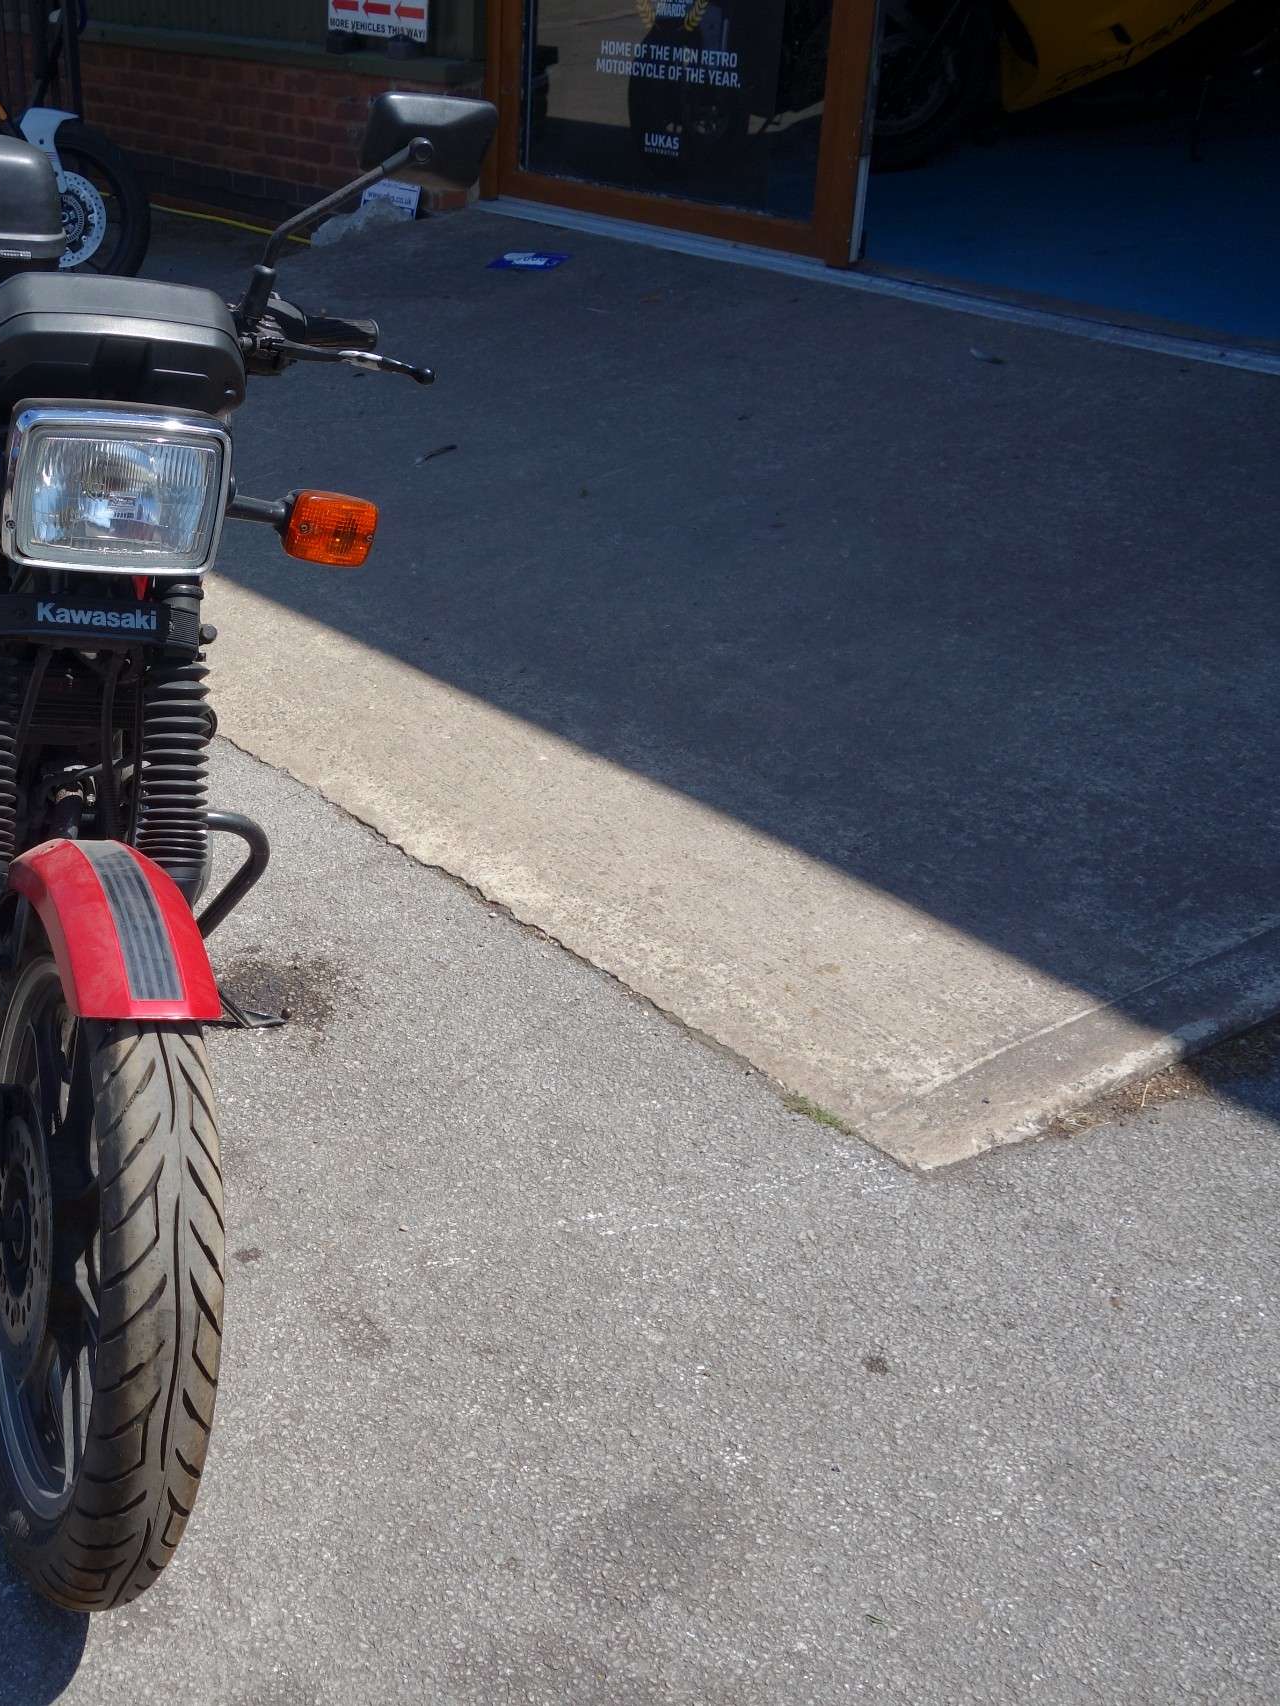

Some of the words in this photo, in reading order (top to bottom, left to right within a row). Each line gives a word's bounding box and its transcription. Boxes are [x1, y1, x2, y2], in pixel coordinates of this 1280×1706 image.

[655, 4, 686, 17] AWARDS
[329, 18, 349, 29] MORE
[351, 20, 386, 33] VEHICLES
[600, 40, 632, 57] HOME
[634, 43, 648, 58] OF
[650, 45, 670, 60] THE
[673, 47, 699, 63] MCN
[701, 51, 738, 67] RETRO
[596, 58, 665, 79] MOTORCYCLE
[668, 65, 682, 81] OF
[685, 67, 705, 83] THE
[708, 70, 741, 88] YEAR.
[644, 132, 680, 149] LUKAS
[37, 602, 157, 630] Kawasaki
